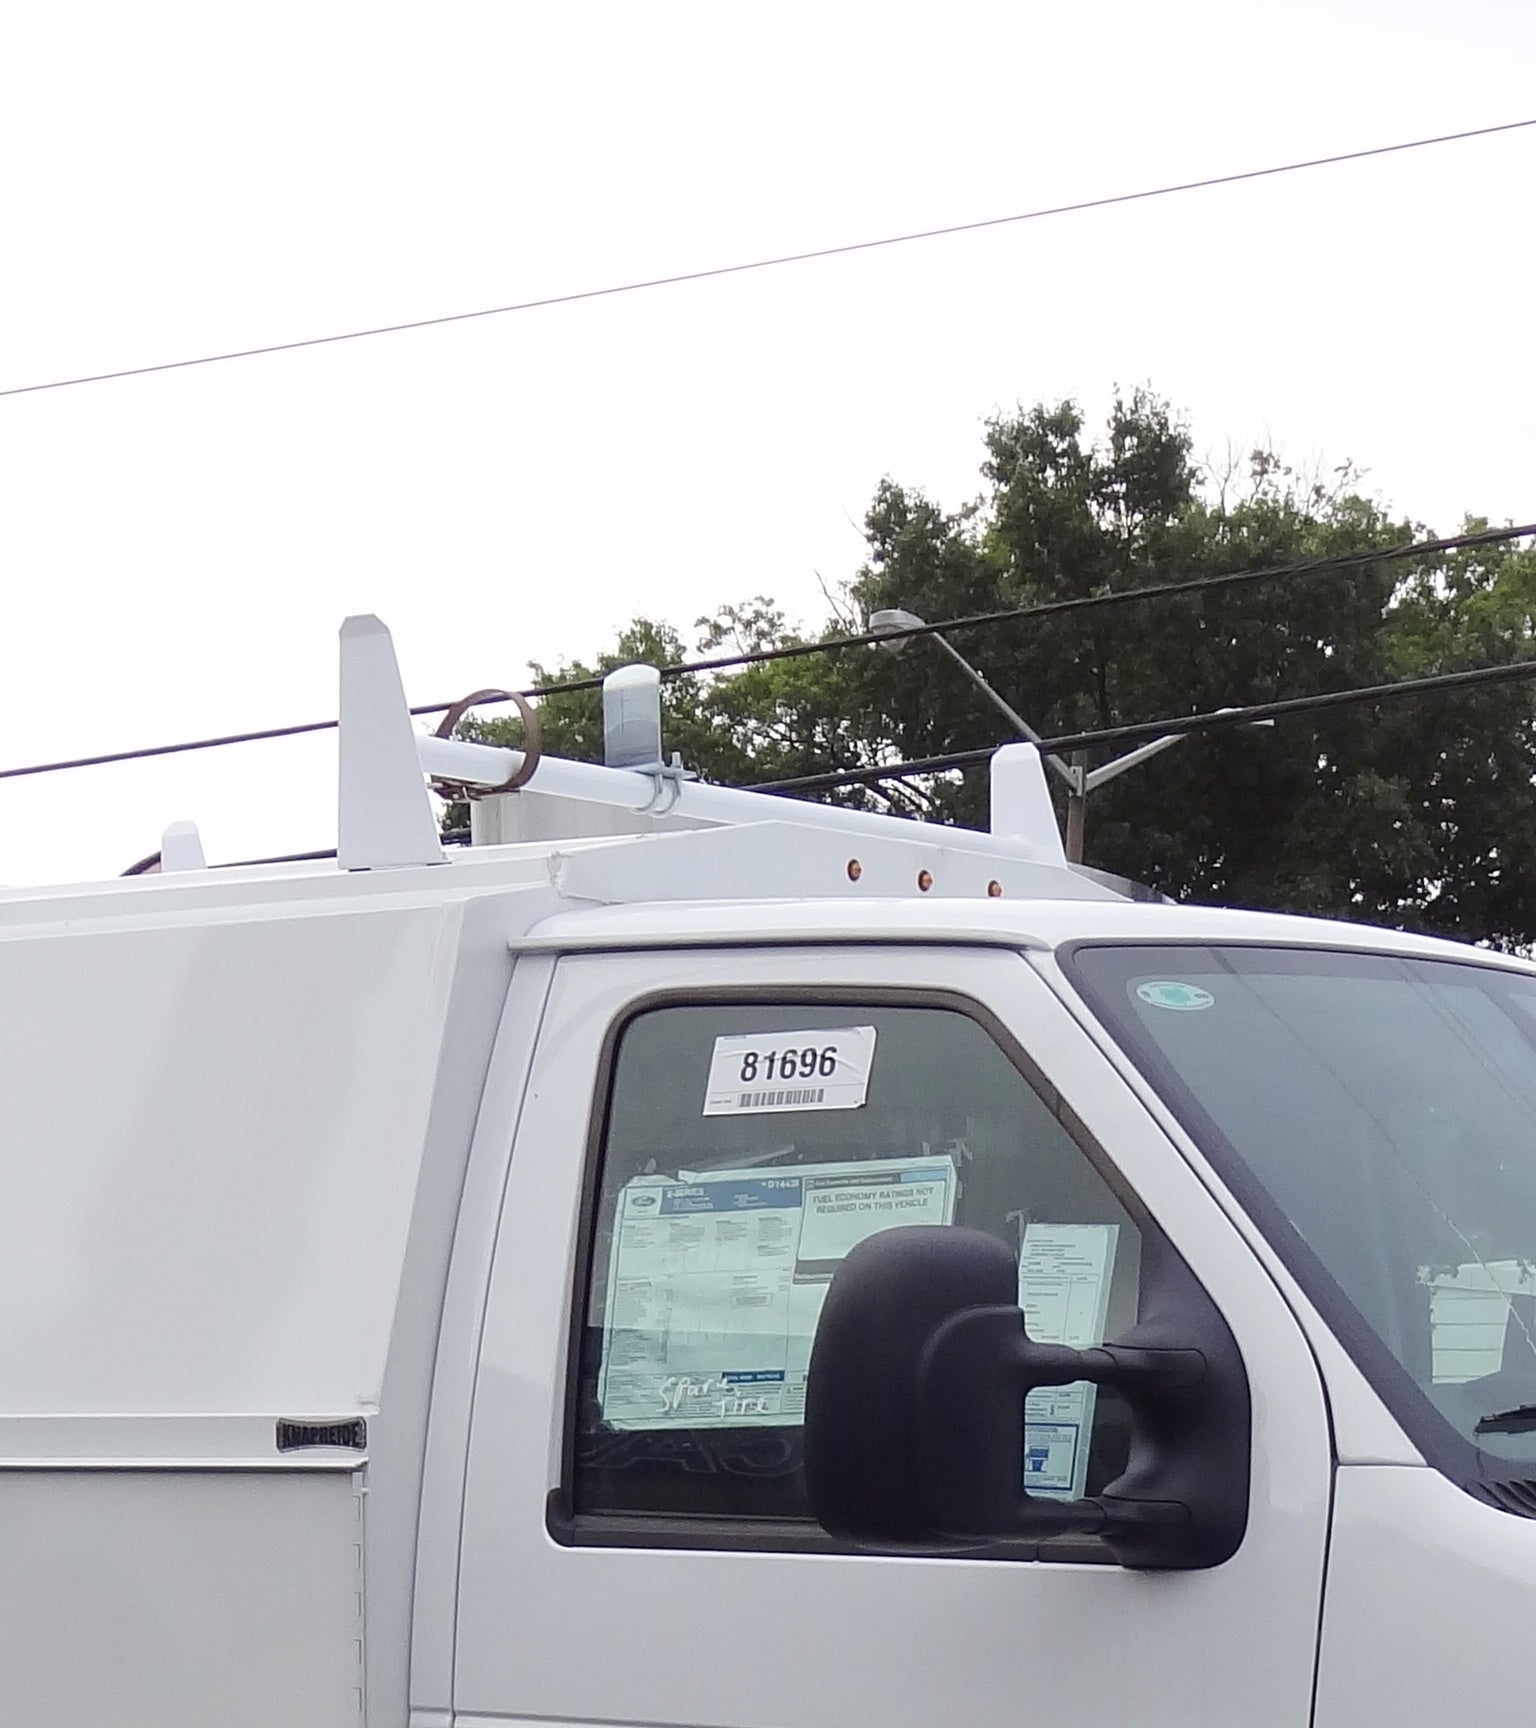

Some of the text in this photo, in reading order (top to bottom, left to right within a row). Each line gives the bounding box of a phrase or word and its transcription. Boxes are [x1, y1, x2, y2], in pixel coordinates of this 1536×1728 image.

[740, 1046, 837, 1082] 81696
[813, 1187, 934, 1204] FUEL ECONOMY RATINGS NOT
[816, 1198, 928, 1214] REQUIRED ON THIS VEHICLE
